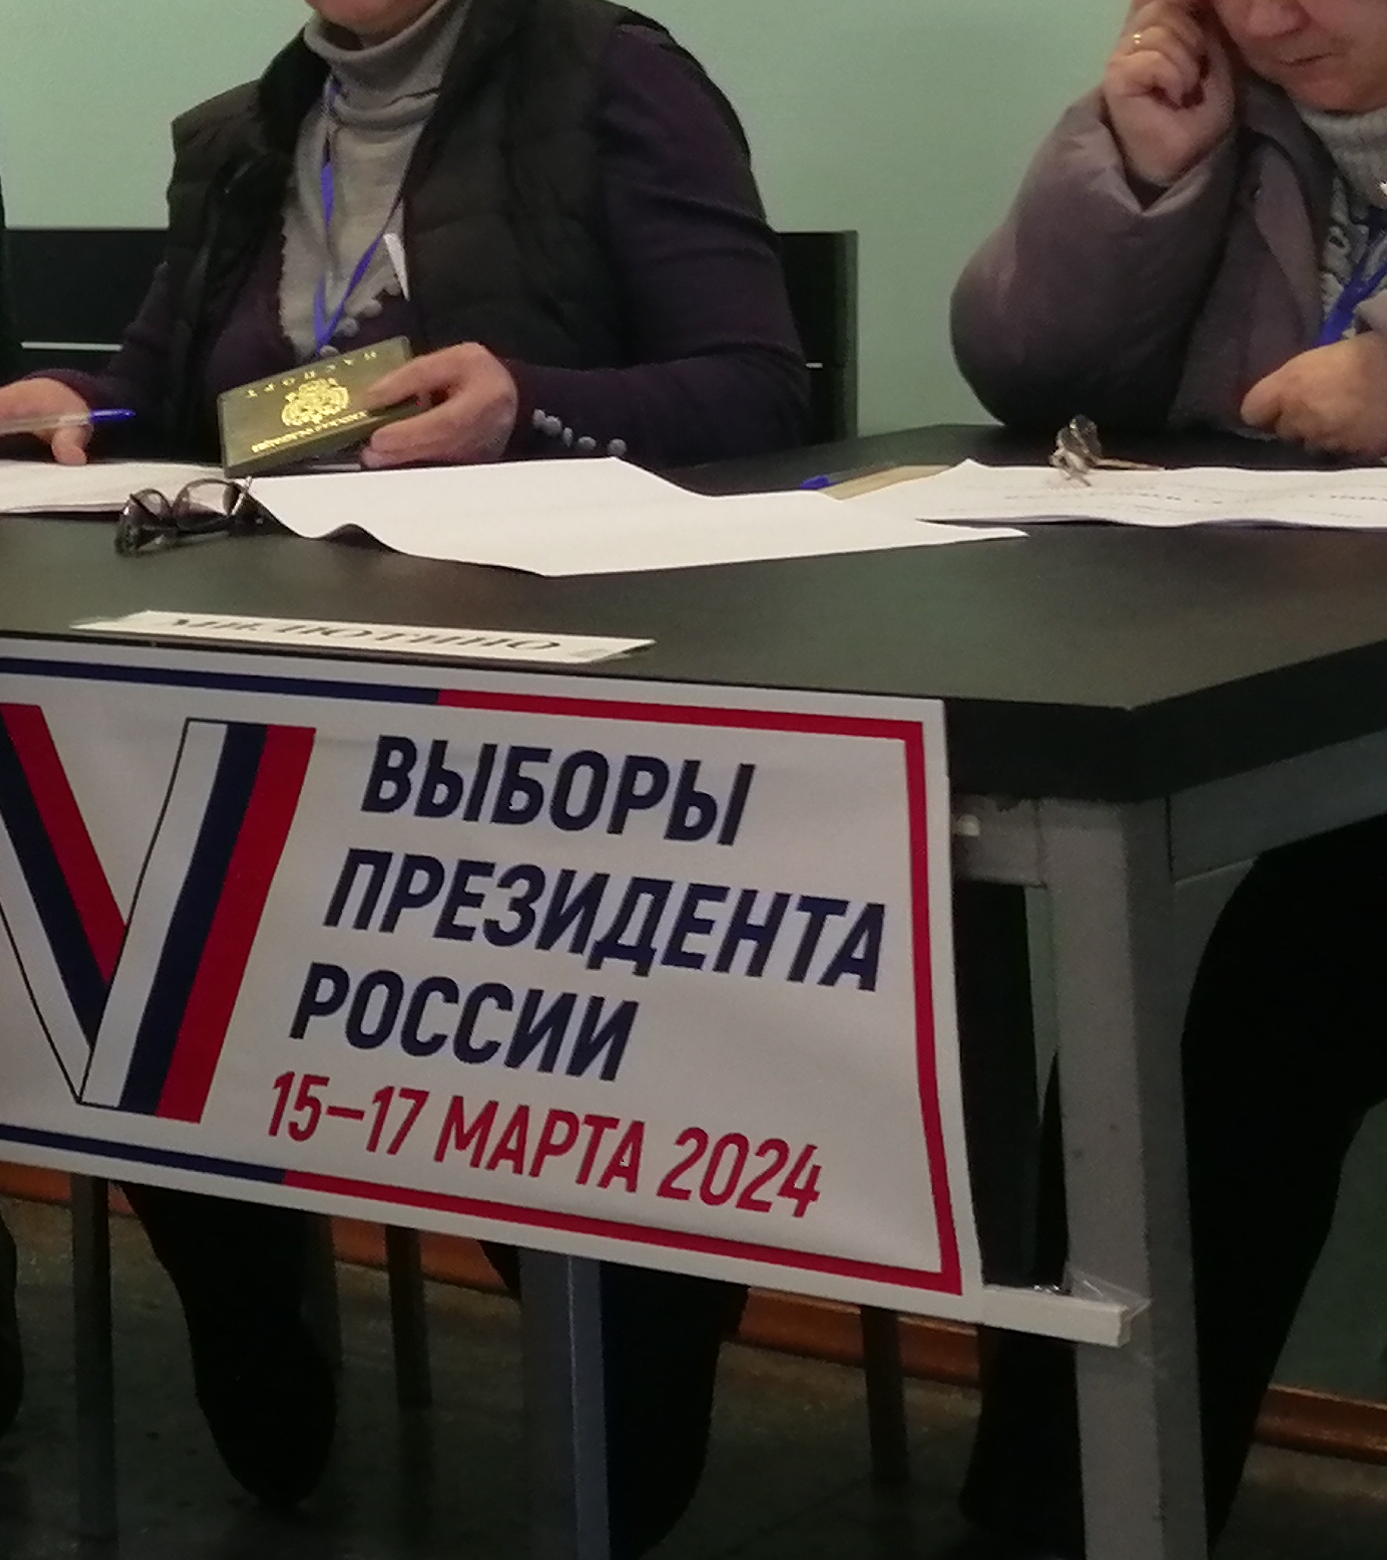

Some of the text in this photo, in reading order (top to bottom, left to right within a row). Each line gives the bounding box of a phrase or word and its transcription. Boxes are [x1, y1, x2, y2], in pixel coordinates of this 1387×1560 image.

[361, 734, 756, 846] ВЫБОРЫ
[323, 847, 886, 992] ПРЕЗИДЕНТА
[289, 961, 639, 1081] РОССИИ
[434, 1095, 645, 1193] МАРТА
[657, 1127, 824, 1218] 2024
